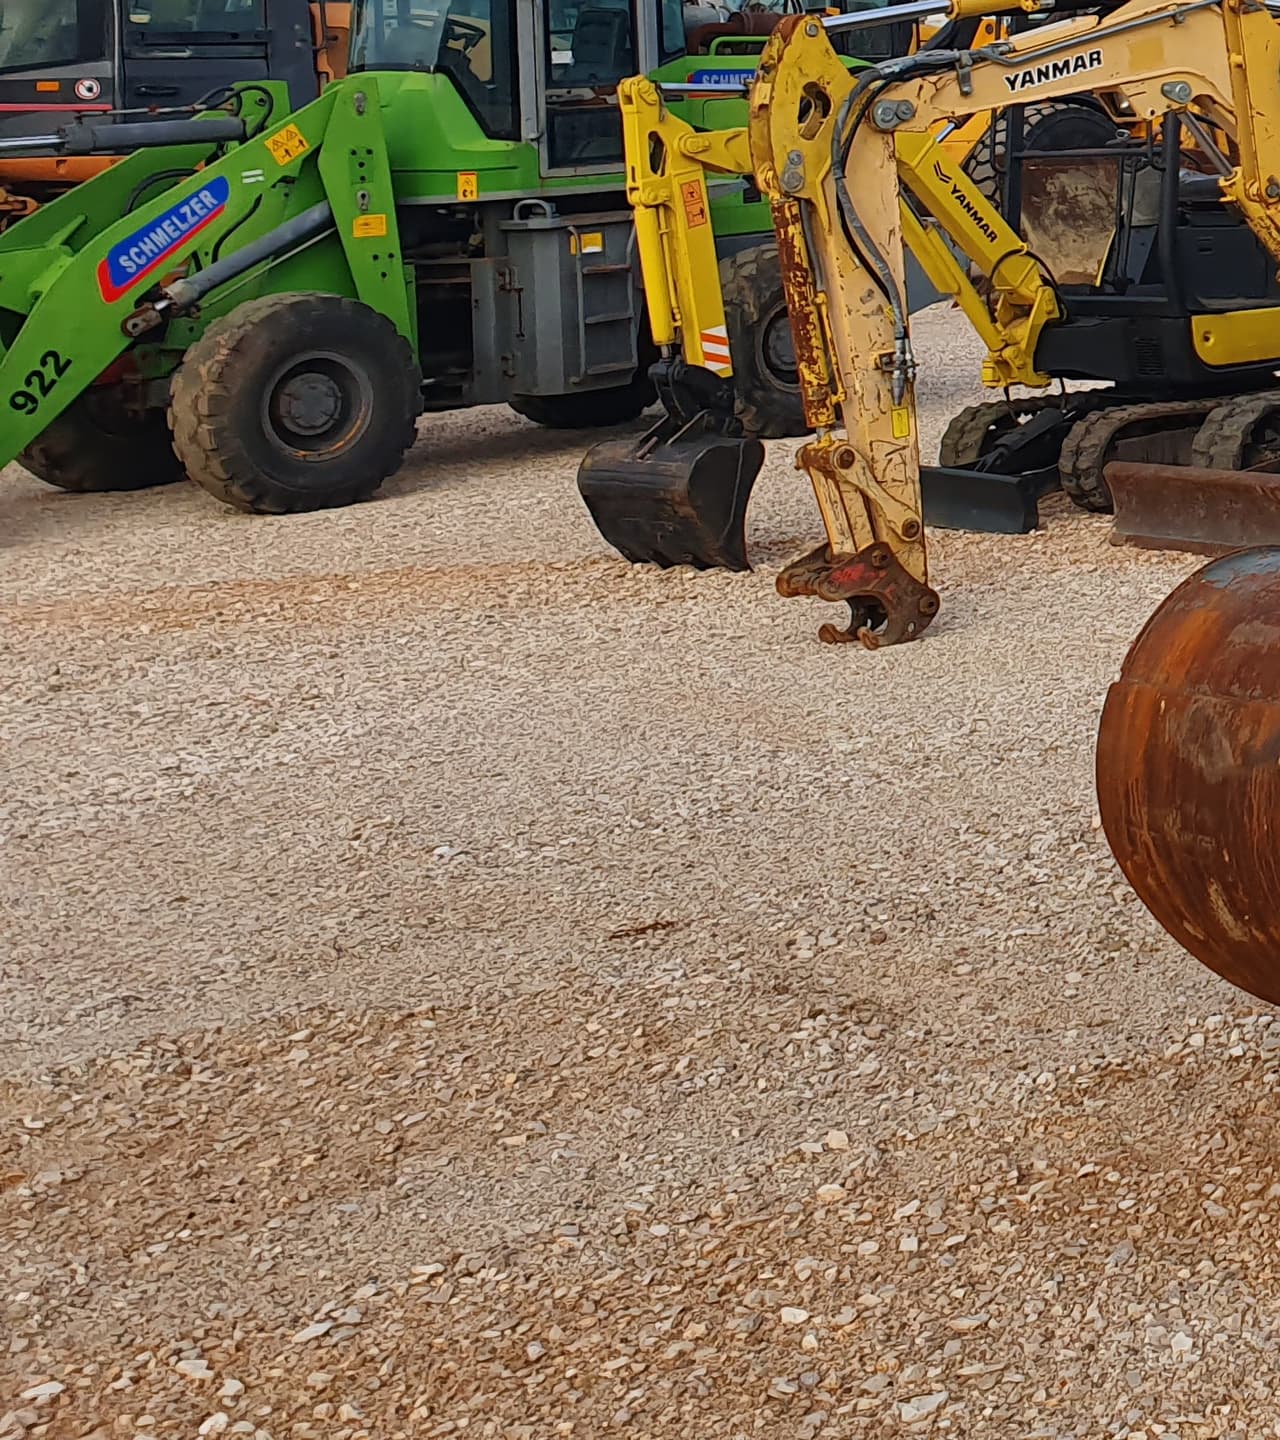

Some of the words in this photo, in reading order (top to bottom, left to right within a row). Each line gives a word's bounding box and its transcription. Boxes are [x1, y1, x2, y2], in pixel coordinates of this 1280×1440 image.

[1004, 49, 1103, 92] YANMAR
[118, 189, 219, 274] SCHMELZER
[951, 182, 998, 244] YANMAR
[9, 350, 73, 415] 922
